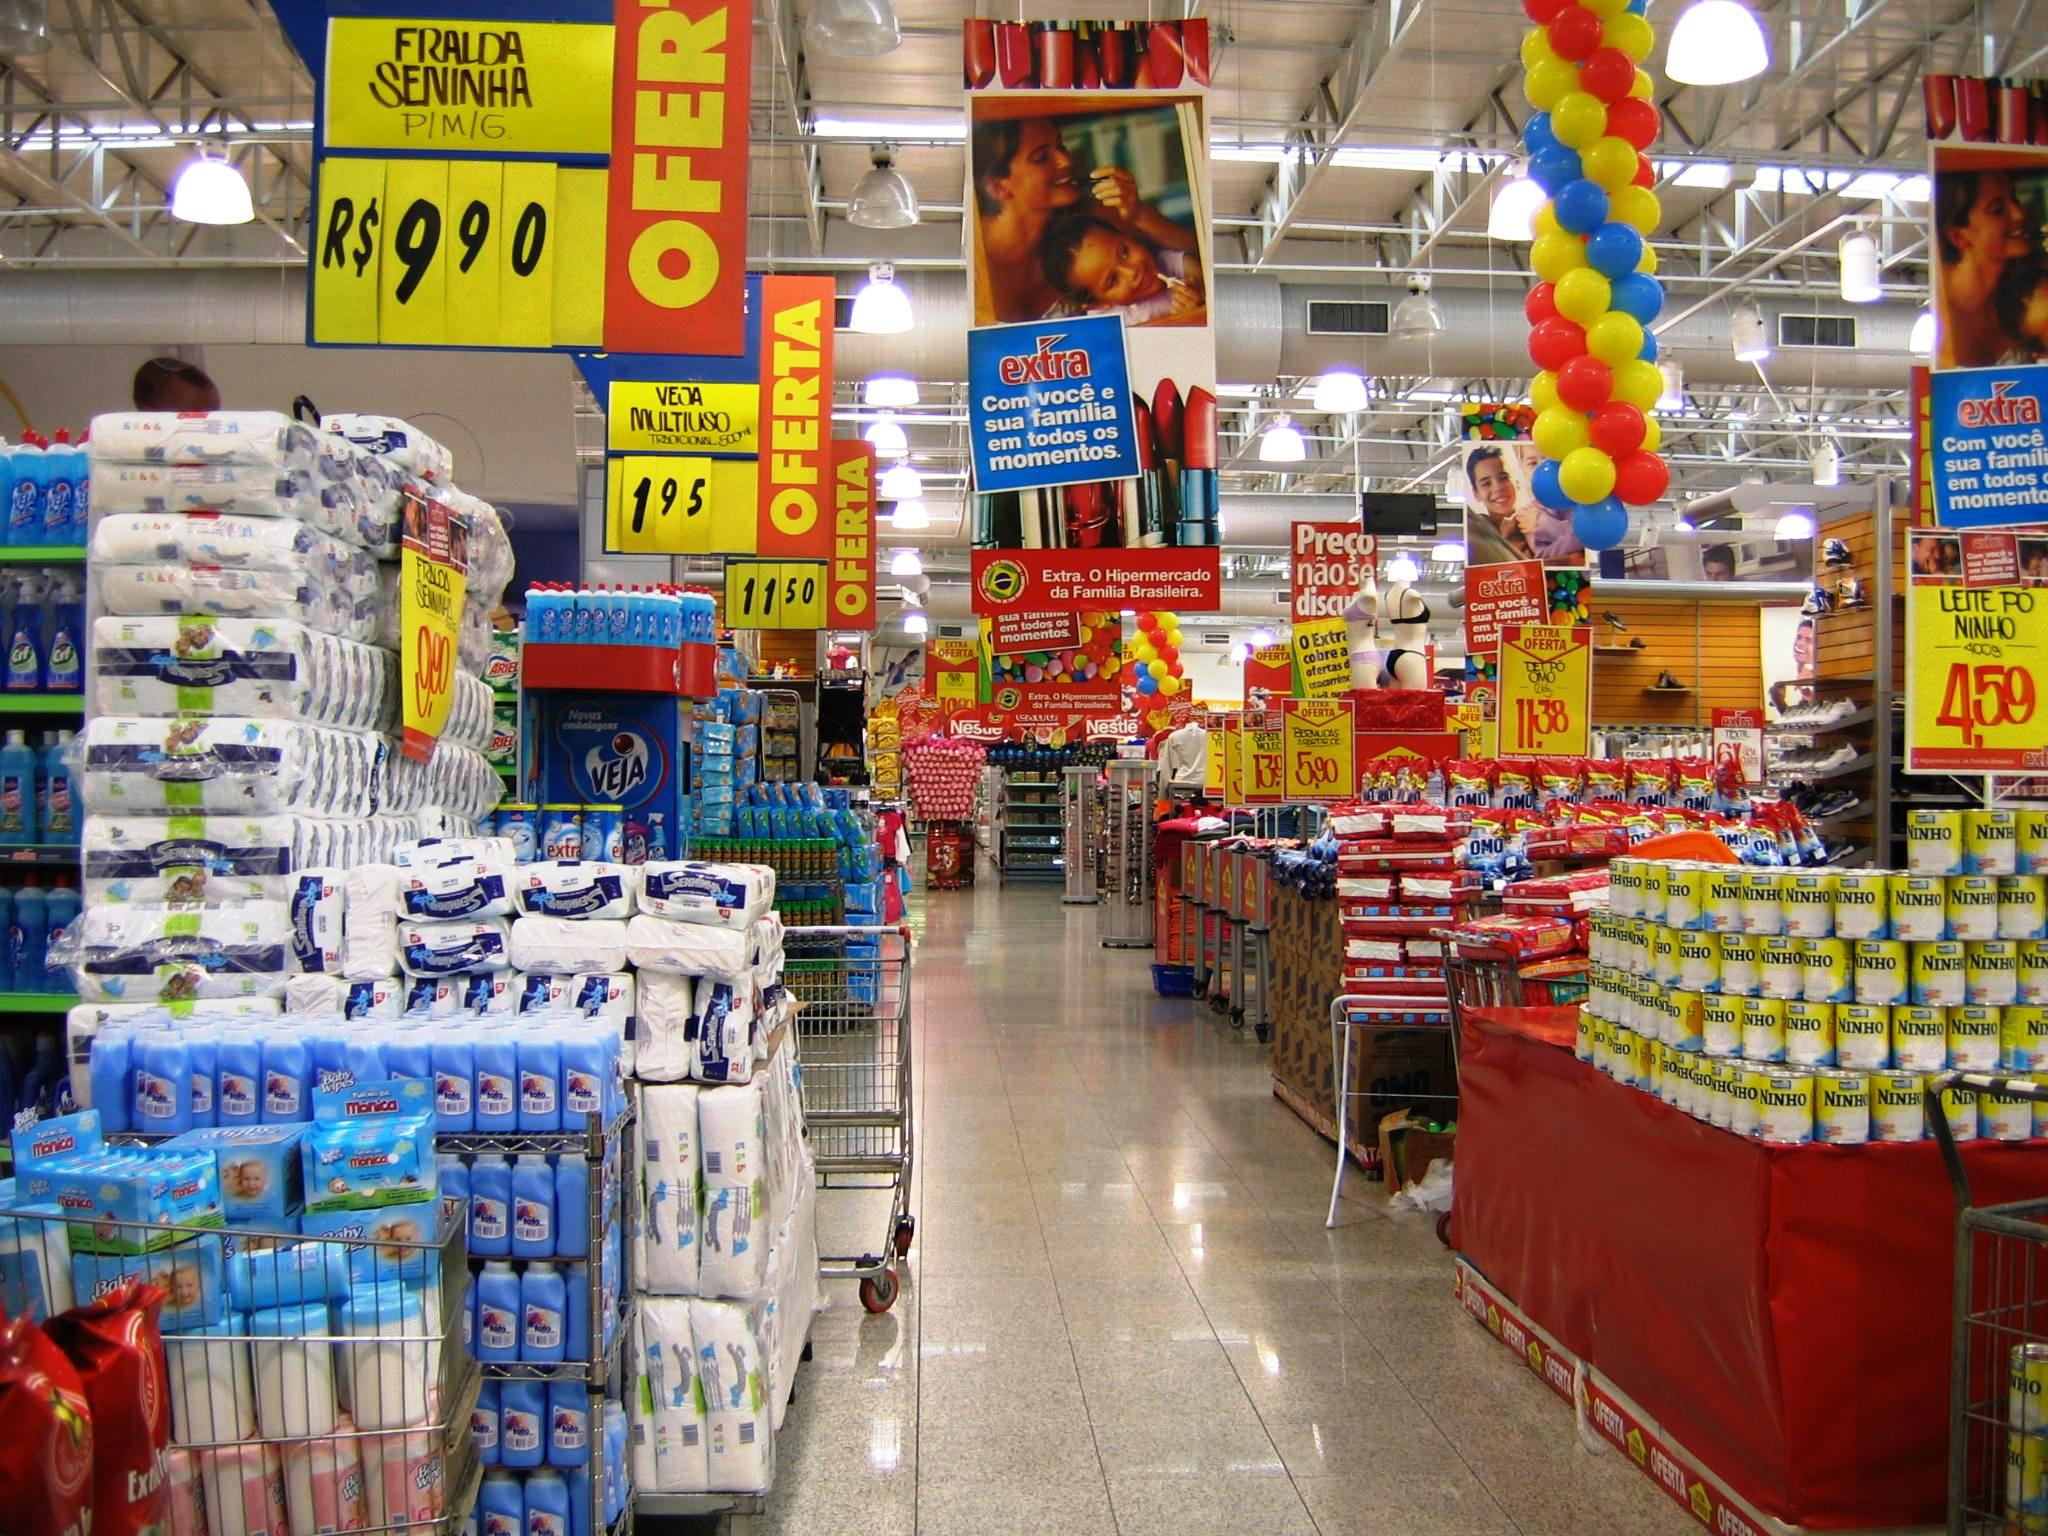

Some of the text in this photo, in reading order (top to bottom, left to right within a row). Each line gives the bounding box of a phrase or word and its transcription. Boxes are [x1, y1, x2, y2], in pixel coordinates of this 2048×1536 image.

[395, 27, 524, 66] FRALDA
[369, 61, 533, 109] SENINHA
[628, 0, 728, 309] OFER
[322, 197, 379, 279] R$
[1000, 345, 1091, 386] extra
[656, 386, 703, 406] VEJA
[982, 384, 1115, 412] Com você e
[770, 299, 821, 536] OFERTA
[984, 403, 1117, 433] sua família
[1957, 393, 2041, 428] extra
[630, 407, 730, 433] MULTIUSO
[987, 426, 1118, 451] em todos os
[1942, 429, 2044, 452] Com você
[989, 443, 1121, 471] momentos.
[1945, 459, 1981, 472] sua
[1948, 472, 2037, 490] em todos
[834, 455, 868, 616] OFERTA
[1296, 524, 1375, 562] Preço
[1042, 568, 1211, 585] Extra. O Hipermercado
[1297, 556, 1345, 586] não
[1050, 585, 1203, 598] da Família Brasileira.
[1478, 575, 1527, 598] extra
[1470, 596, 1539, 612] Com você e
[1939, 590, 1995, 612] LEITE
[1471, 606, 1540, 622] sua família
[1000, 619, 1070, 633] em todos os
[1472, 624, 1491, 633] em
[1532, 628, 1560, 638] EXTRA
[1954, 615, 2015, 640] NINHO
[1000, 628, 1071, 644] momentos.
[1299, 635, 1309, 650] O
[1524, 638, 1567, 650] OFERTA
[938, 649, 974, 658] OFERTA
[1256, 649, 1291, 660] OFERTA
[1303, 647, 1338, 664] cobre
[1306, 662, 1342, 677] ofertas
[1528, 672, 1556, 683] OMO
[1301, 708, 1335, 718] OFERTA
[1936, 662, 2036, 749] 4,59
[568, 710, 602, 720] Novas
[591, 755, 645, 796] VEJA
[1469, 838, 1503, 856] OMO
[1785, 888, 1830, 903] NINHO
[1896, 890, 1941, 905] NINHO
[1952, 889, 1996, 905] NINHO
[1970, 954, 2015, 970] NINHO
[1838, 1017, 1884, 1034] NINHO
[1898, 1019, 1943, 1036] NINHO
[1951, 1019, 1997, 1035] NINHO
[321, 1079, 354, 1093] Wipes
[322, 1071, 351, 1084] Baby
[1760, 1089, 1806, 1107] NINHO
[1502, 1317, 1526, 1352] OFERTA
[1544, 1355, 1572, 1397] OFERTA
[1593, 1397, 1625, 1445] OFERTA
[1650, 1446, 1688, 1500] OFERTA
